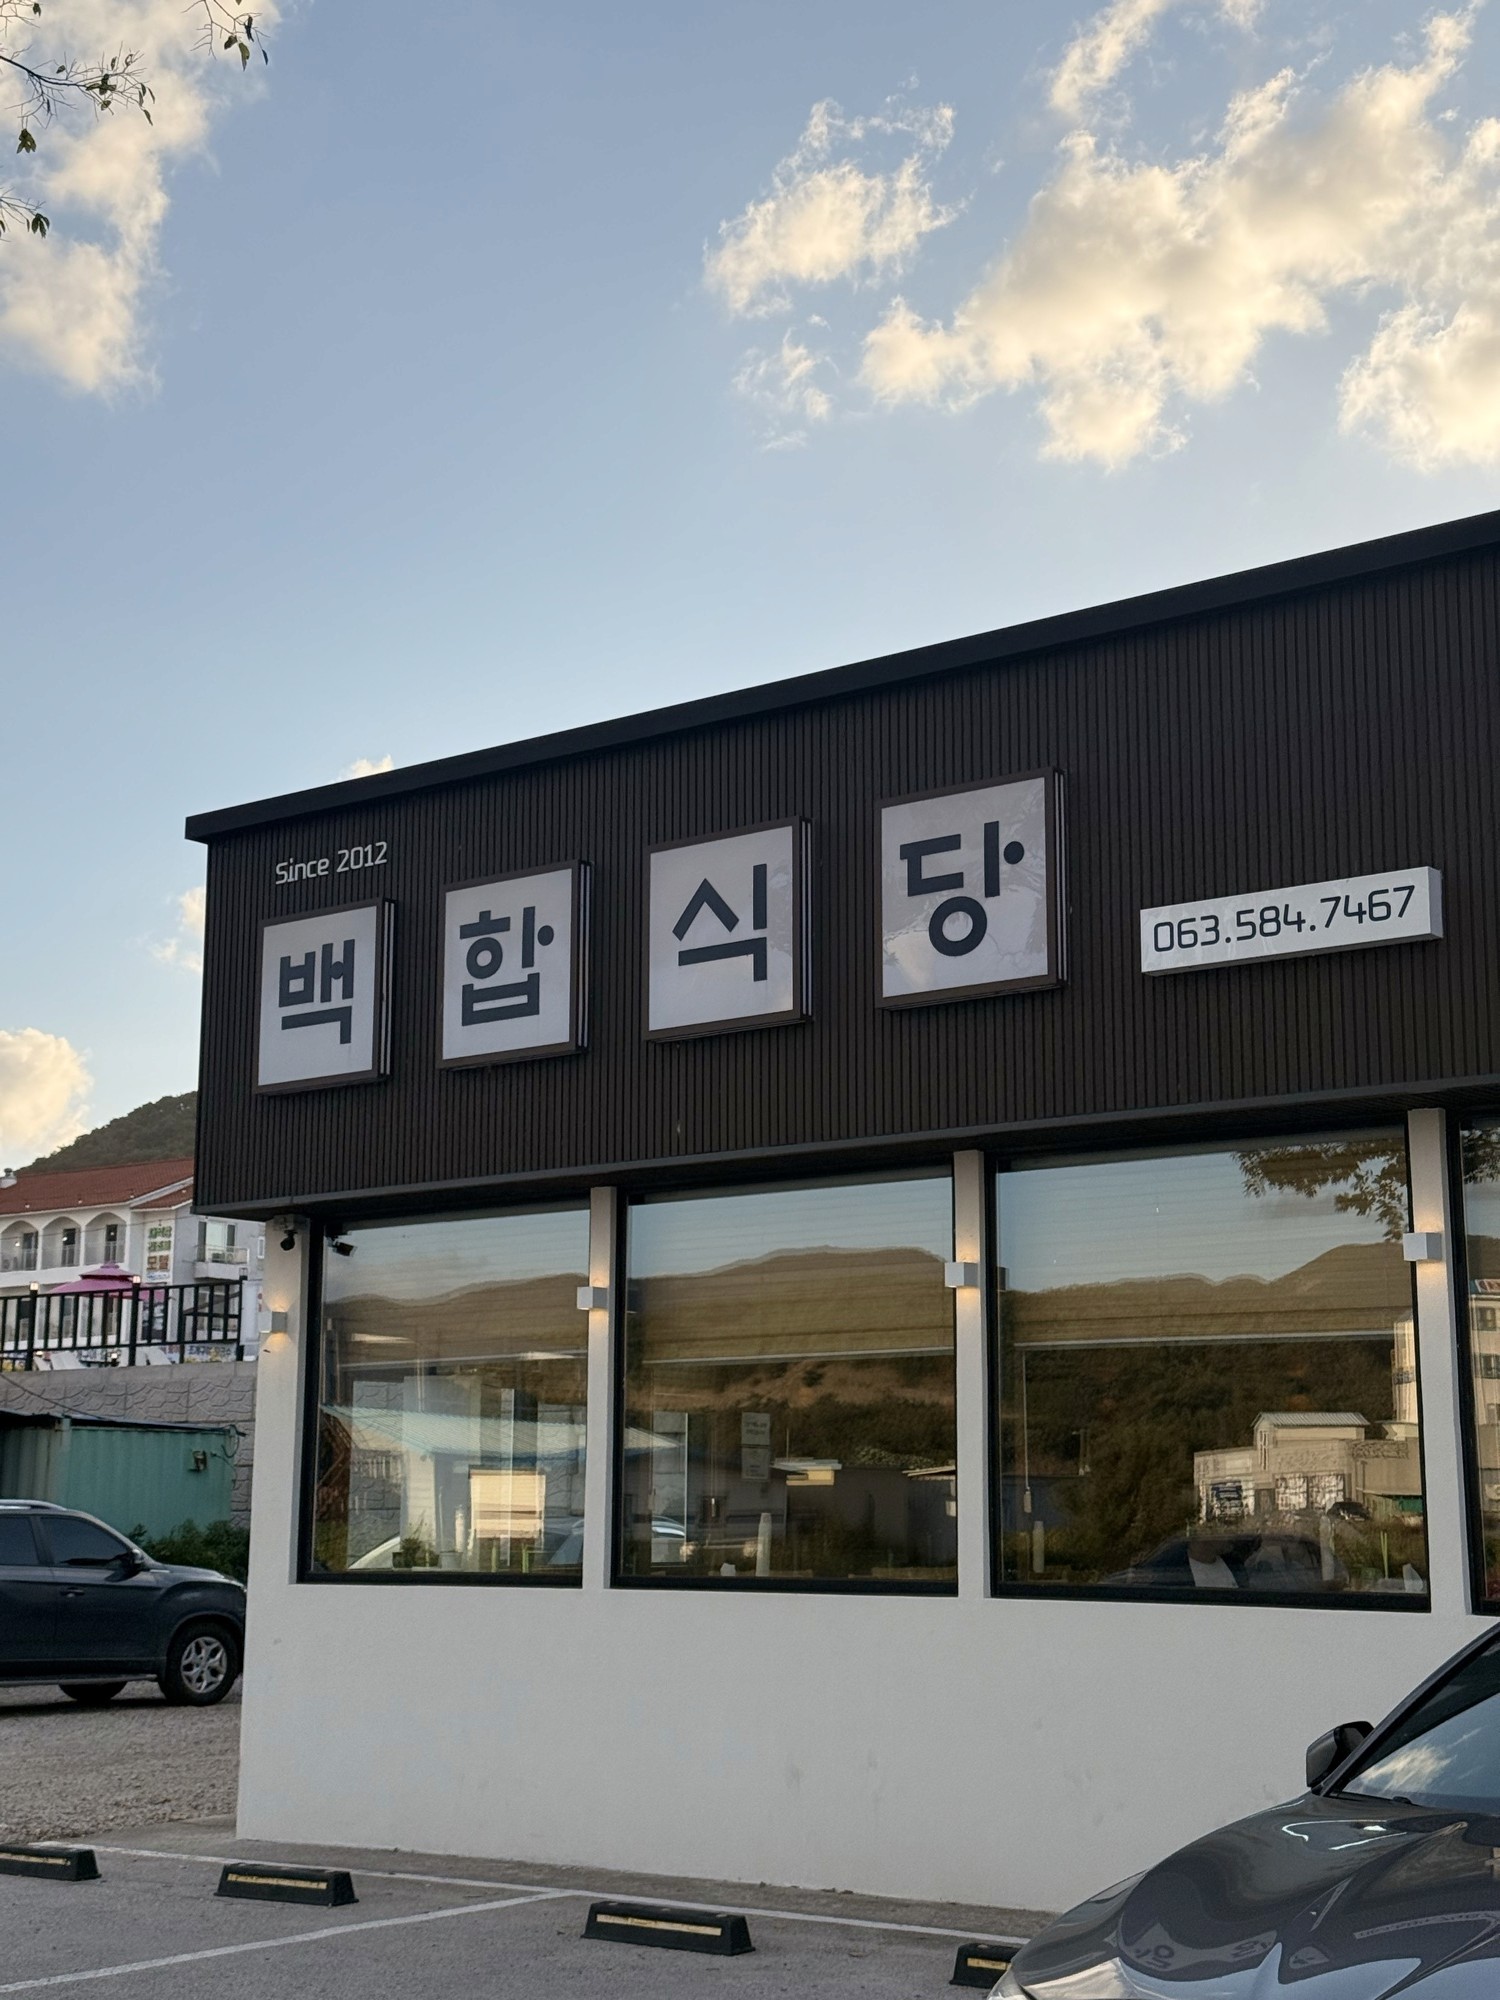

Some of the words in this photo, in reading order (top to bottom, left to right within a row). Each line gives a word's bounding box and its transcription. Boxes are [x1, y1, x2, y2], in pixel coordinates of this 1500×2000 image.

[275, 857, 330, 885] Since
[336, 841, 388, 873] 2012
[278, 821, 1025, 1045] 백합식당
[1153, 884, 1416, 953] 063.584.7467
